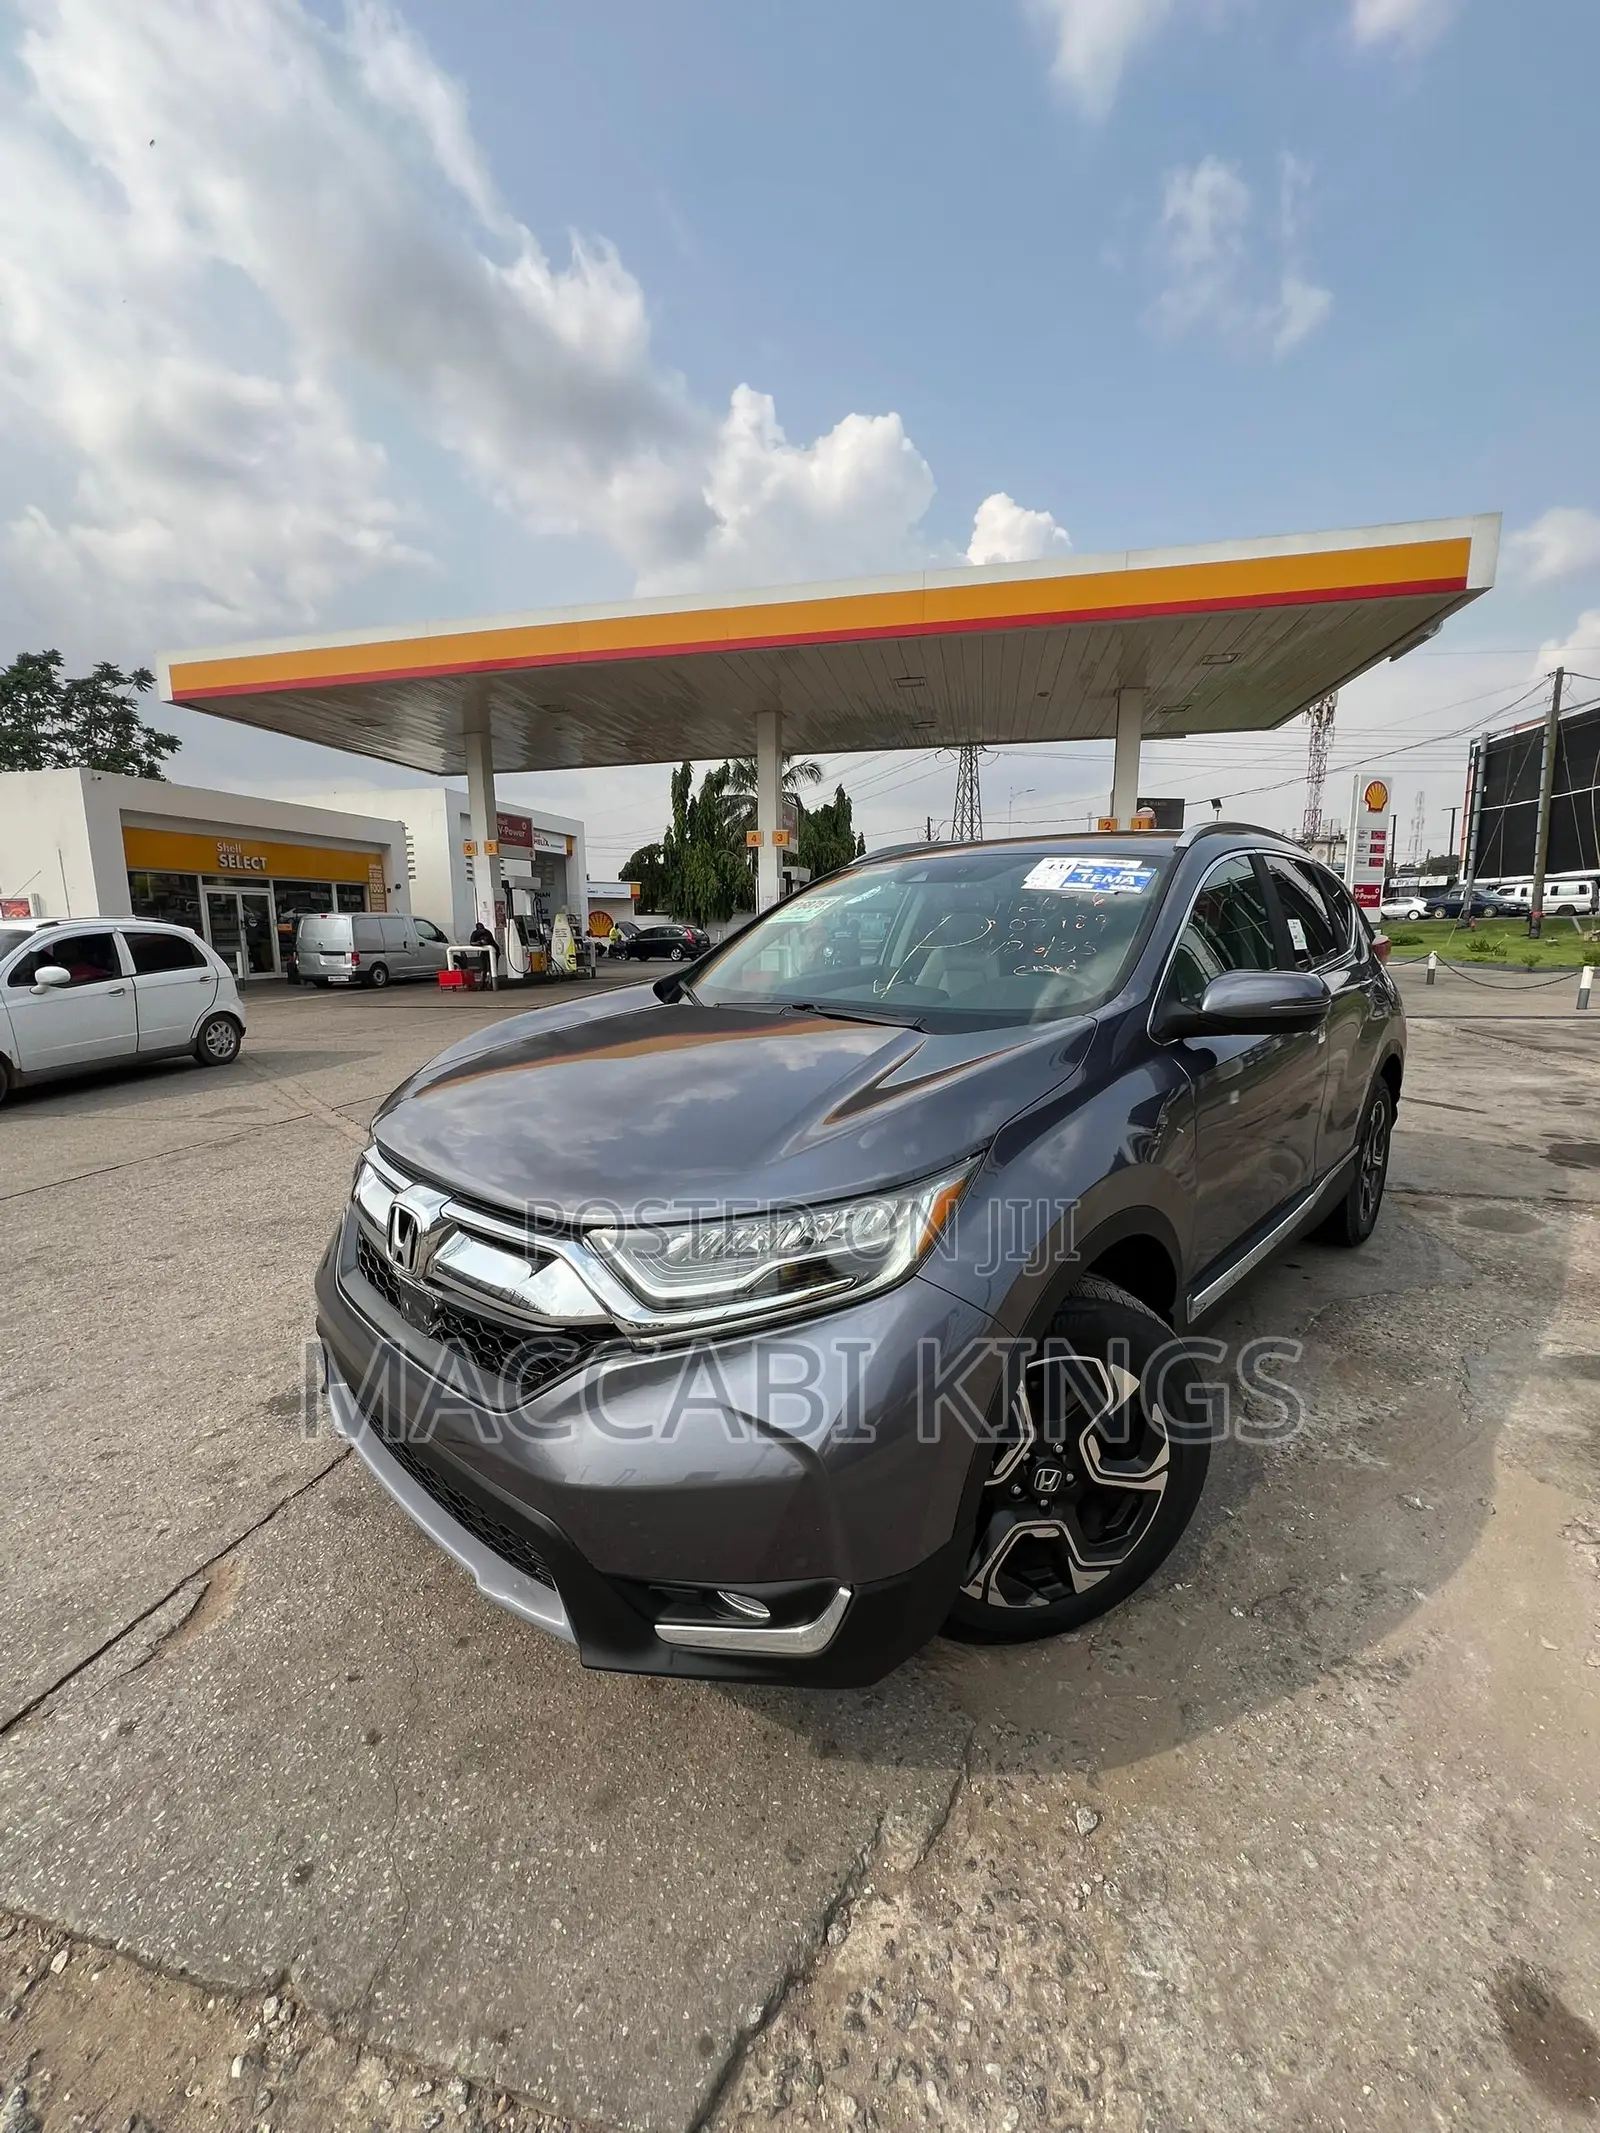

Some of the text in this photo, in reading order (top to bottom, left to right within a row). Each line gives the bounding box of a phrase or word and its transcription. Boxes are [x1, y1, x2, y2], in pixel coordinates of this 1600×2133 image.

[497, 826, 526, 838] V-Power
[1104, 822, 1111, 830] 2
[751, 834, 757, 842] 4
[776, 834, 783, 842] 3
[216, 842, 242, 854] Shell
[219, 854, 268, 870] SELECT
[1080, 873, 1136, 886] TEMA
